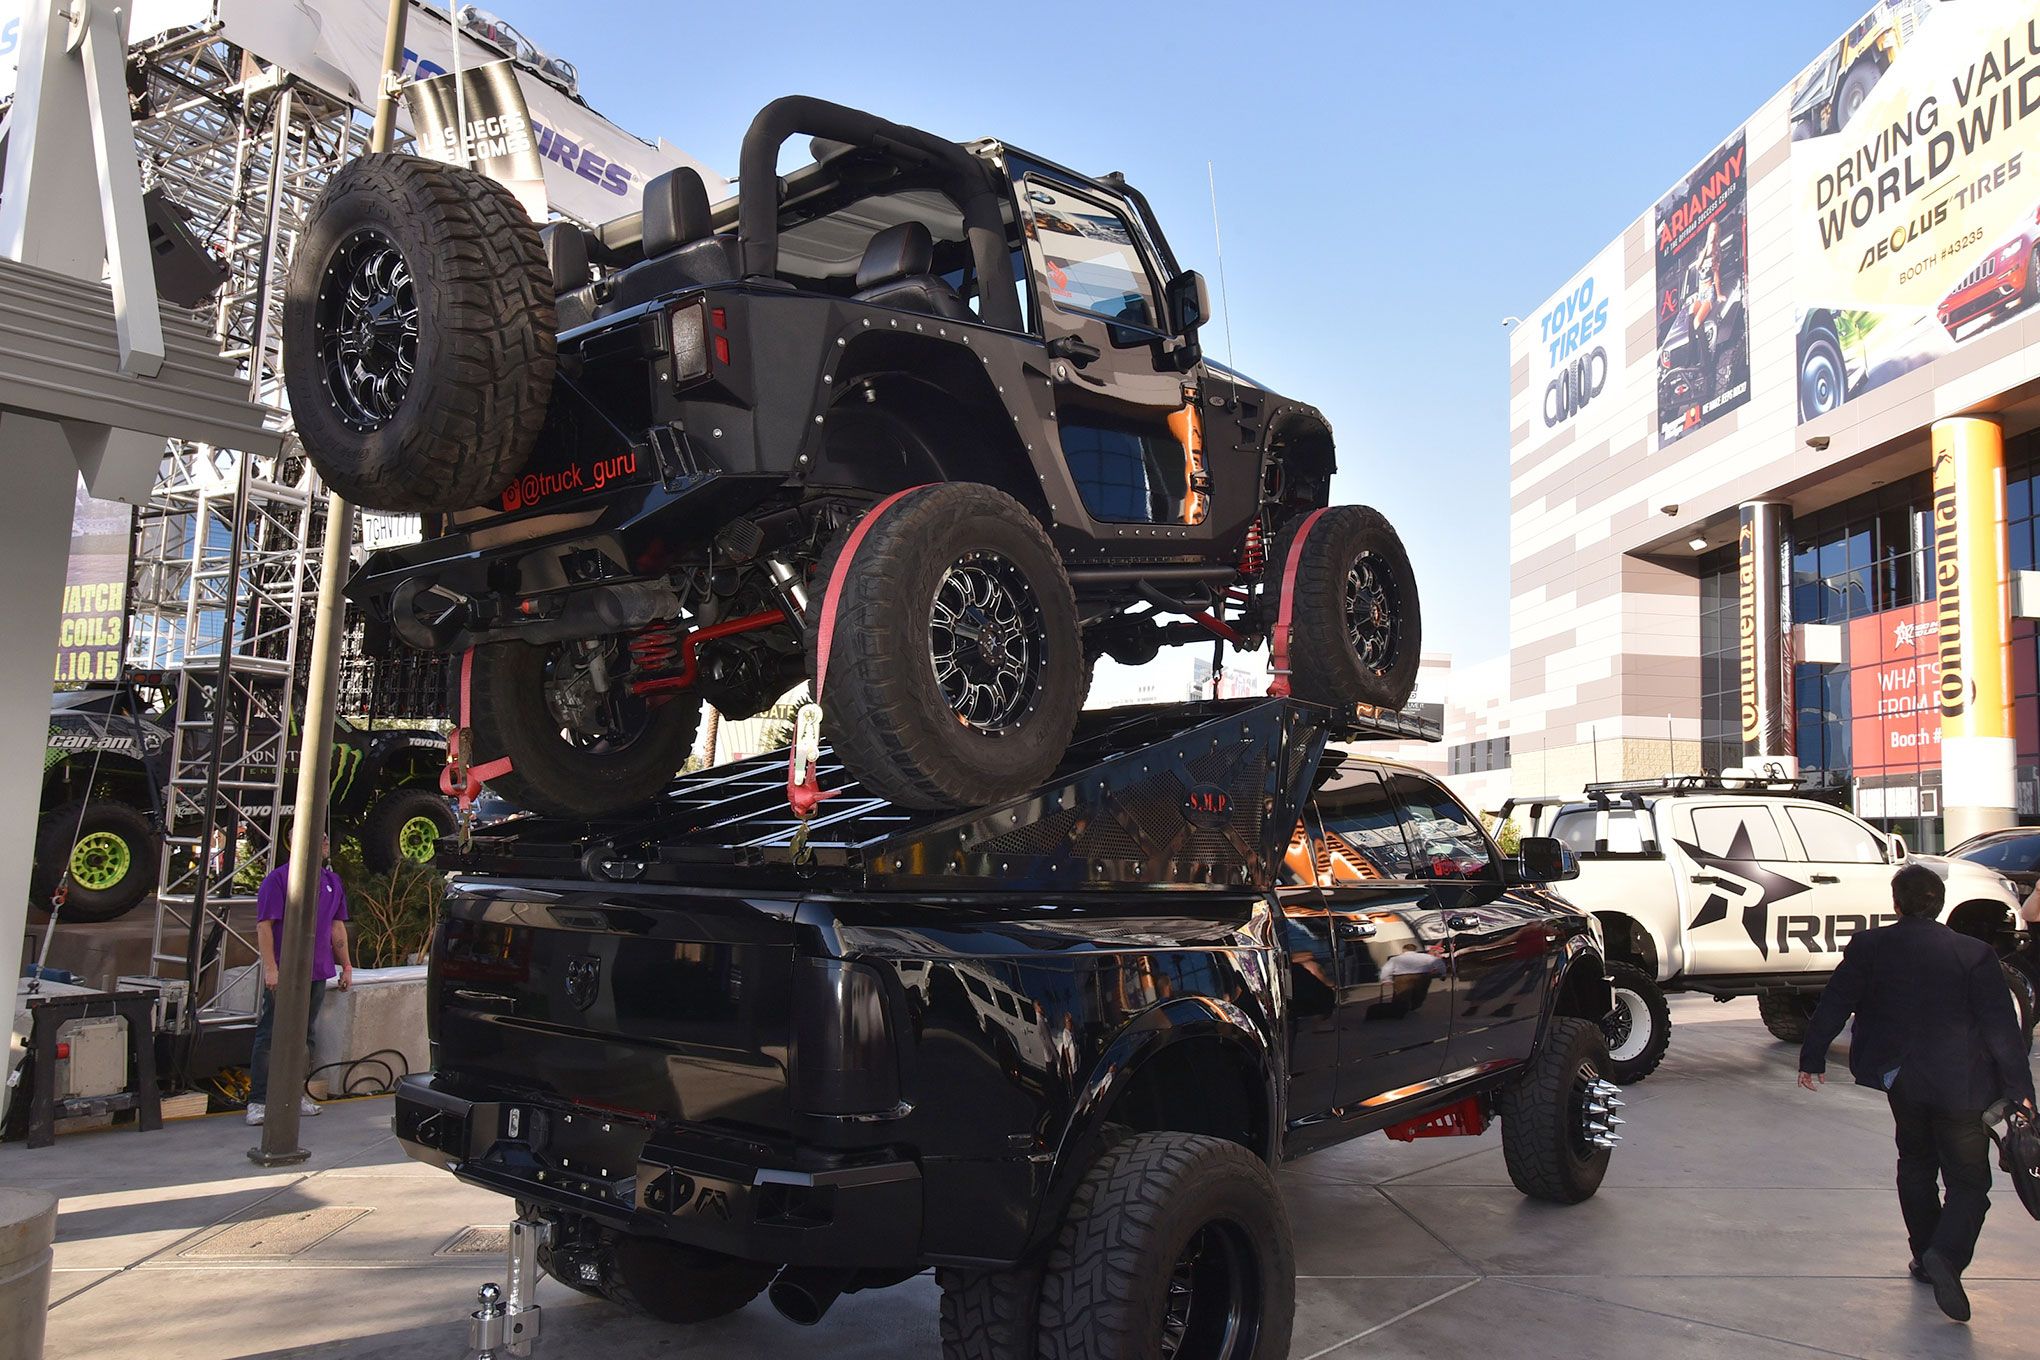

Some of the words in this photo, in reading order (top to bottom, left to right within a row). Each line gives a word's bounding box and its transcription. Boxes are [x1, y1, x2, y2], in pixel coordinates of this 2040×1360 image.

[1816, 96, 1938, 211] DRIVING
[1659, 146, 1744, 251] ARIANNY
[1858, 198, 1949, 273] AEOLUS
[1953, 151, 2023, 210] TIRES
[1899, 255, 1937, 284] BOOTH
[1941, 227, 1984, 262] #43235
[1541, 276, 1594, 343] TOYO
[1549, 297, 1609, 368] TIRES
[521, 452, 637, 505] @truck_guru
[58, 616, 122, 648] COIL3
[1878, 694, 1929, 721] FROM
[48, 734, 133, 750] can-am
[408, 737, 433, 748] TOYO
[1890, 727, 1930, 748] Booth
